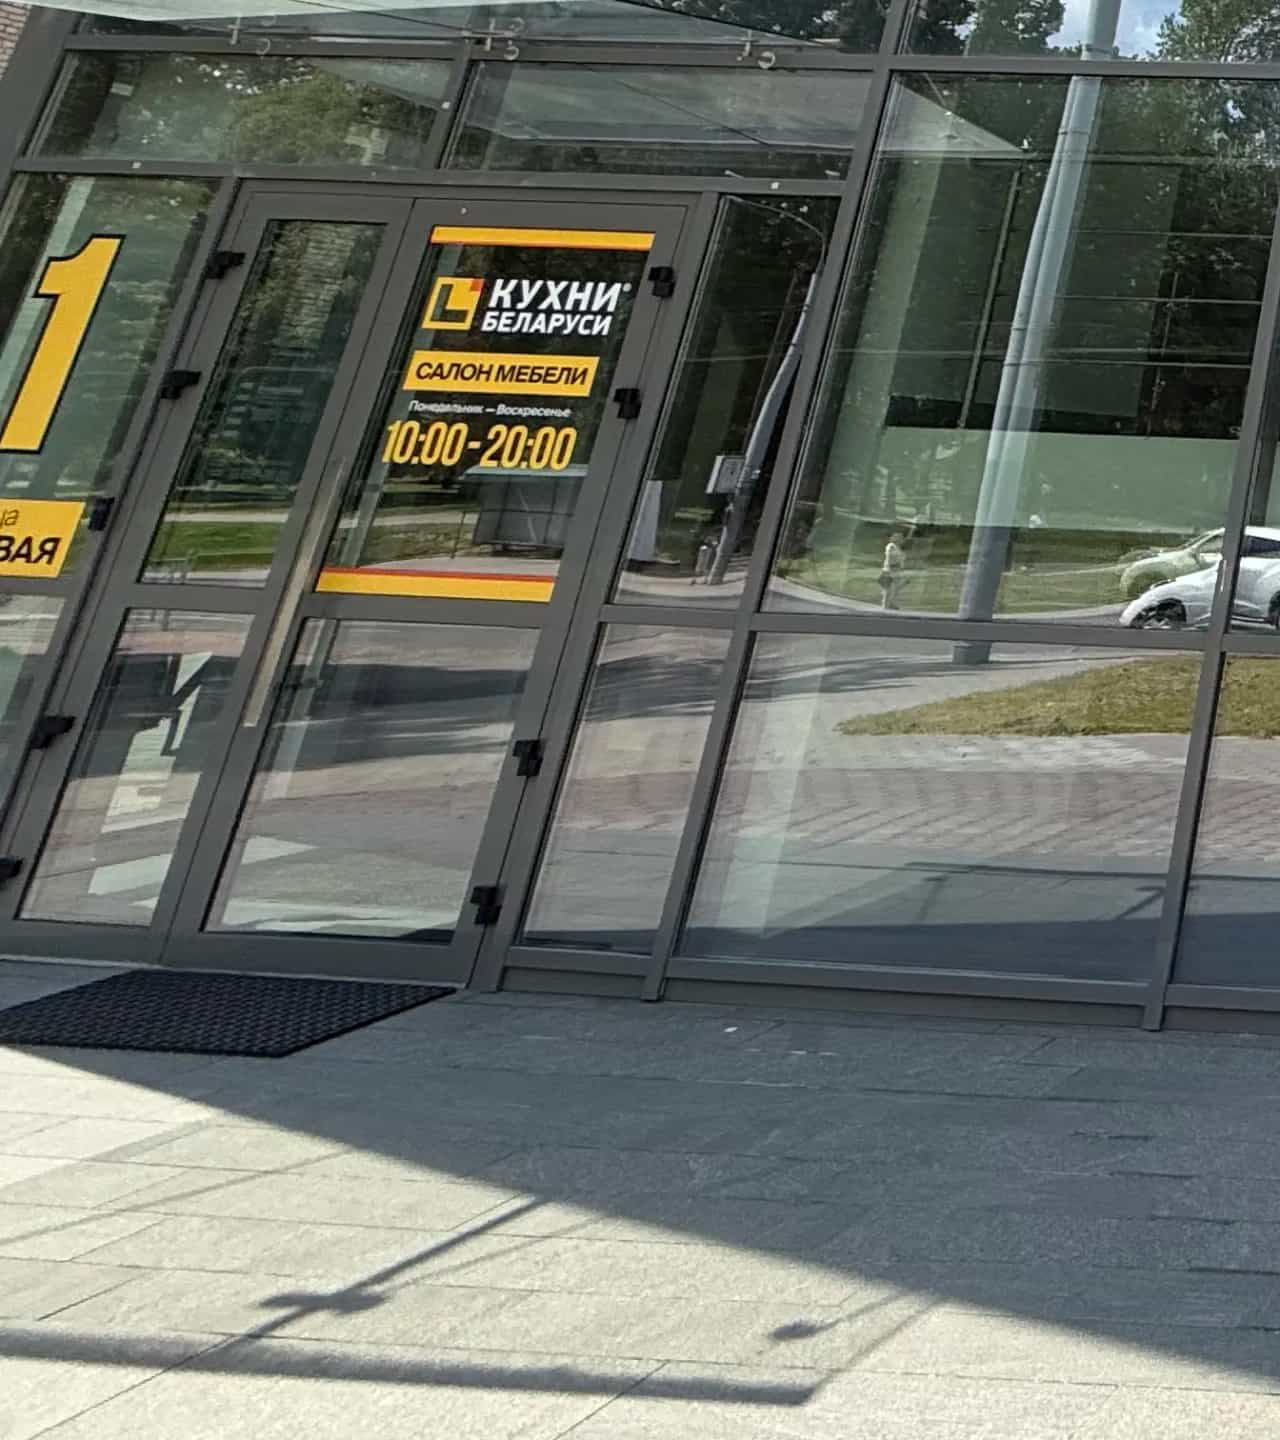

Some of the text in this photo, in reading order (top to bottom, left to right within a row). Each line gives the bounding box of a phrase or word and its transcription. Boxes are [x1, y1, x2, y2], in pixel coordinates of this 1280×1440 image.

[488, 278, 622, 312] КУХНИ
[481, 311, 613, 336] БЕЛАРУСИ
[415, 362, 589, 386] САЛОН МЕБЕЛИ
[408, 400, 484, 415] Понедельник
[496, 403, 572, 418] Воскресенье
